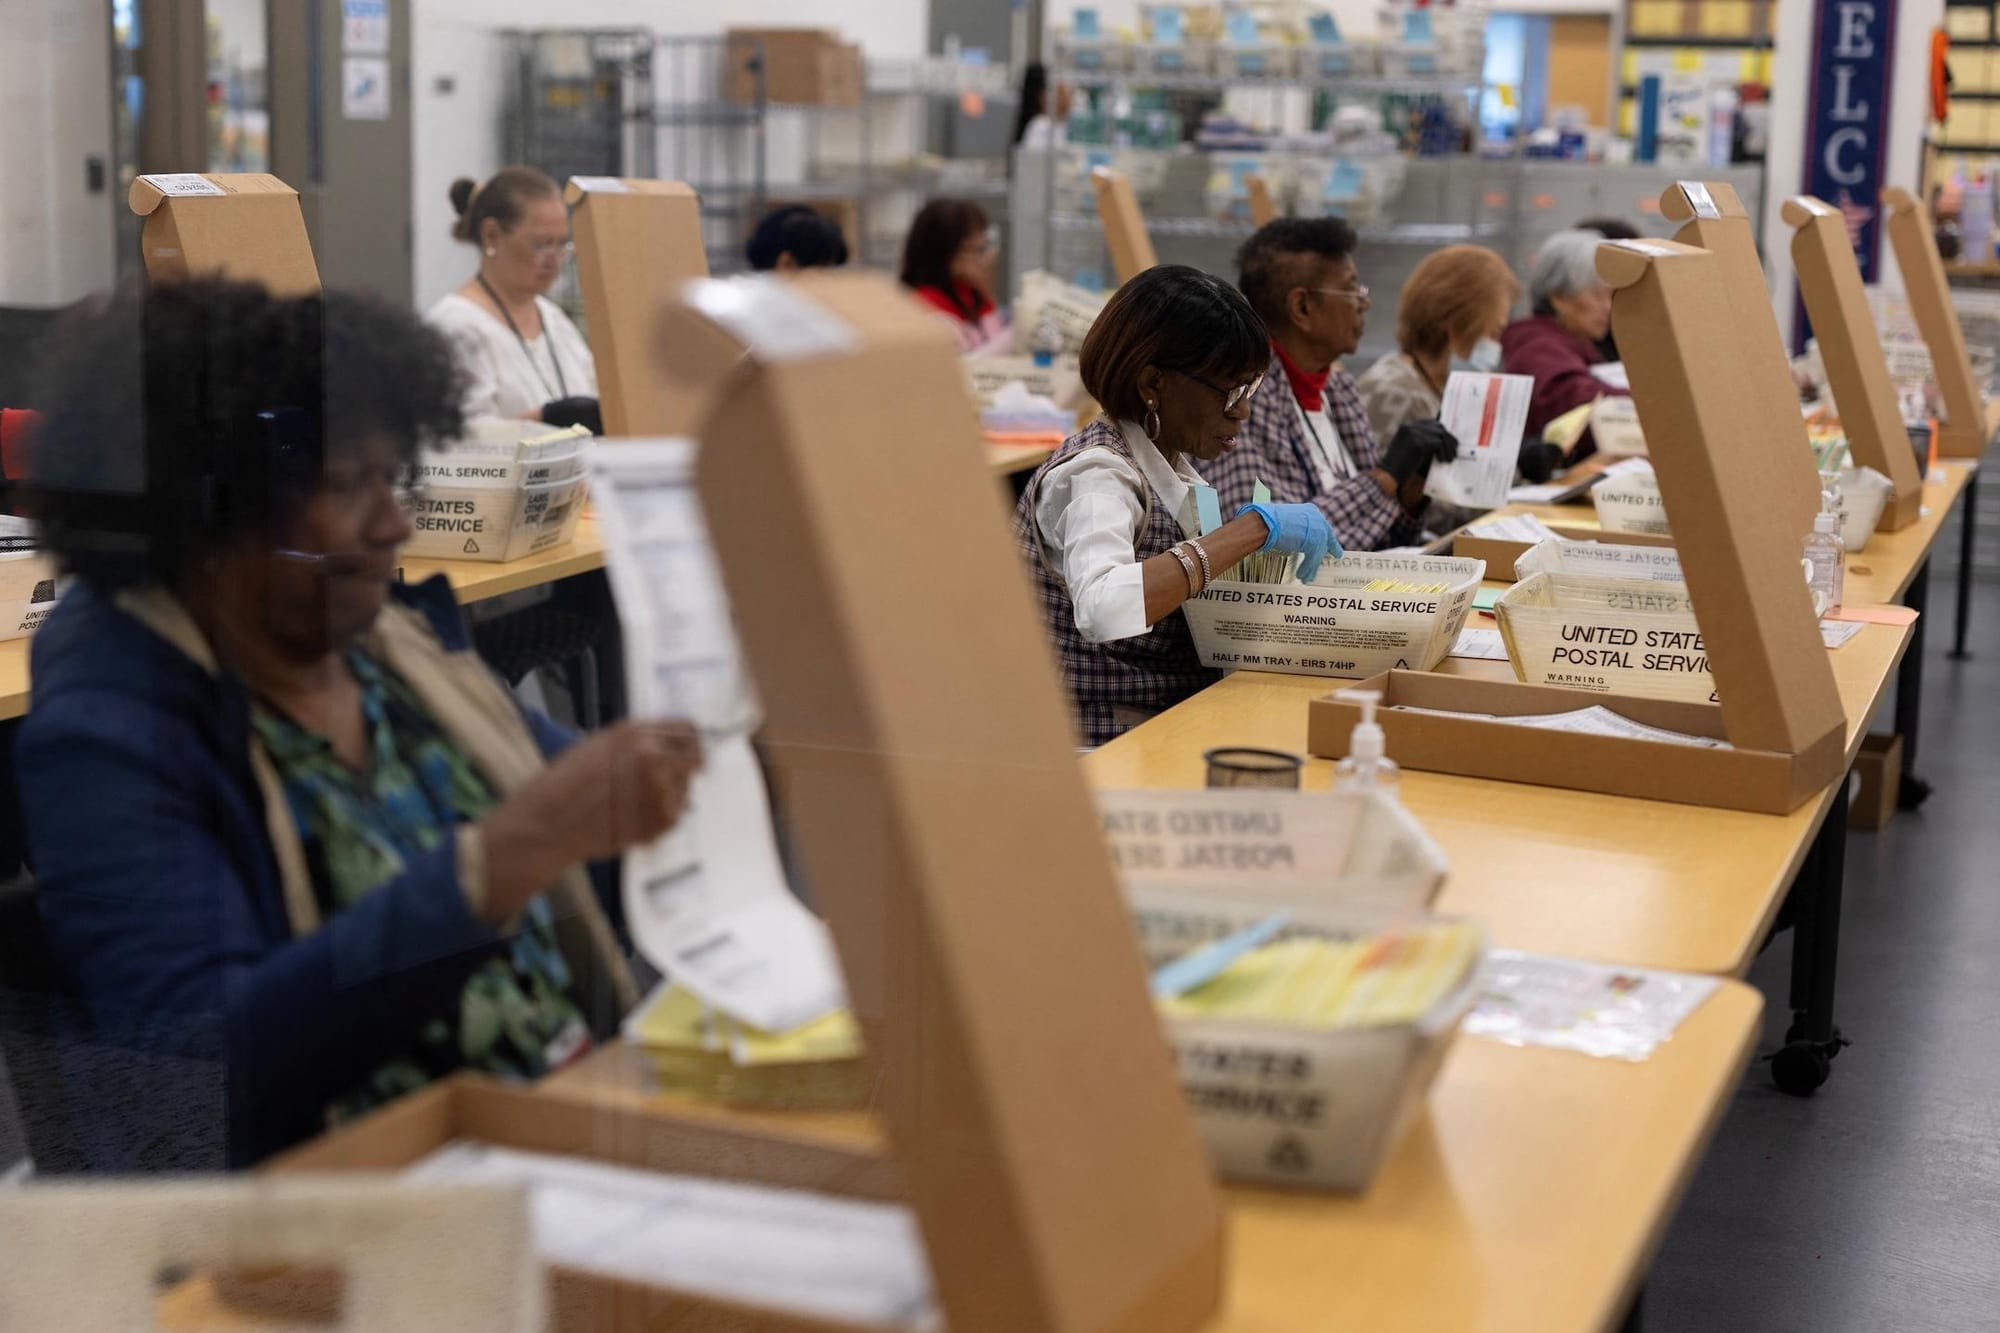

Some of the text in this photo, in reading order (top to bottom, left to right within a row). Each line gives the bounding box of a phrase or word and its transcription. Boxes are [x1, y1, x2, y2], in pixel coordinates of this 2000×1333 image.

[455, 467, 508, 479] SERVICE
[416, 500, 475, 514] STATES
[1601, 493, 1645, 506] UNITED
[415, 517, 484, 533] SERVICE
[1246, 591, 1303, 607] STATES
[1307, 596, 1366, 611] POSTAL
[1370, 600, 1438, 614] SERVICE
[1284, 614, 1336, 626] WARNING
[1561, 624, 1638, 646] UNITED
[1212, 652, 1241, 663] HALF
[1243, 654, 1261, 665] MM
[1263, 656, 1292, 666] TRAY
[1301, 658, 1326, 669] EIRS
[1329, 660, 1356, 671] 74HP
[1552, 647, 1634, 669] POSTAL
[1547, 673, 1604, 685] WARNING
